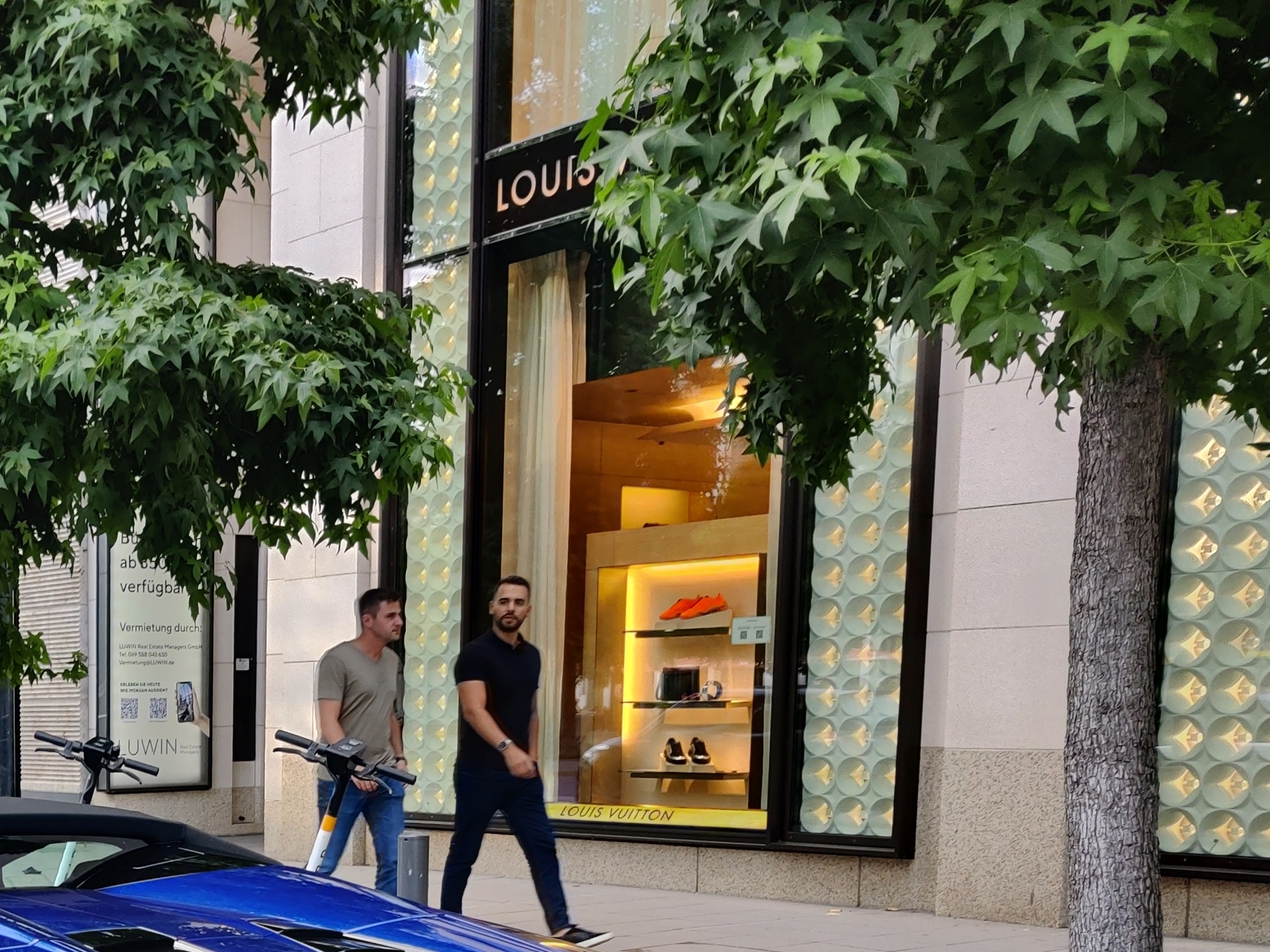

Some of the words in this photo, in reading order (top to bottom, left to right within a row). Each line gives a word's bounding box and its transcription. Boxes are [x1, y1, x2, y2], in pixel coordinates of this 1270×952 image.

[120, 555, 137, 569] ab
[119, 622, 172, 634] Vermietung
[174, 622, 202, 633] durch:
[560, 805, 603, 819] LOUIS
[609, 807, 675, 822] VUITTON
